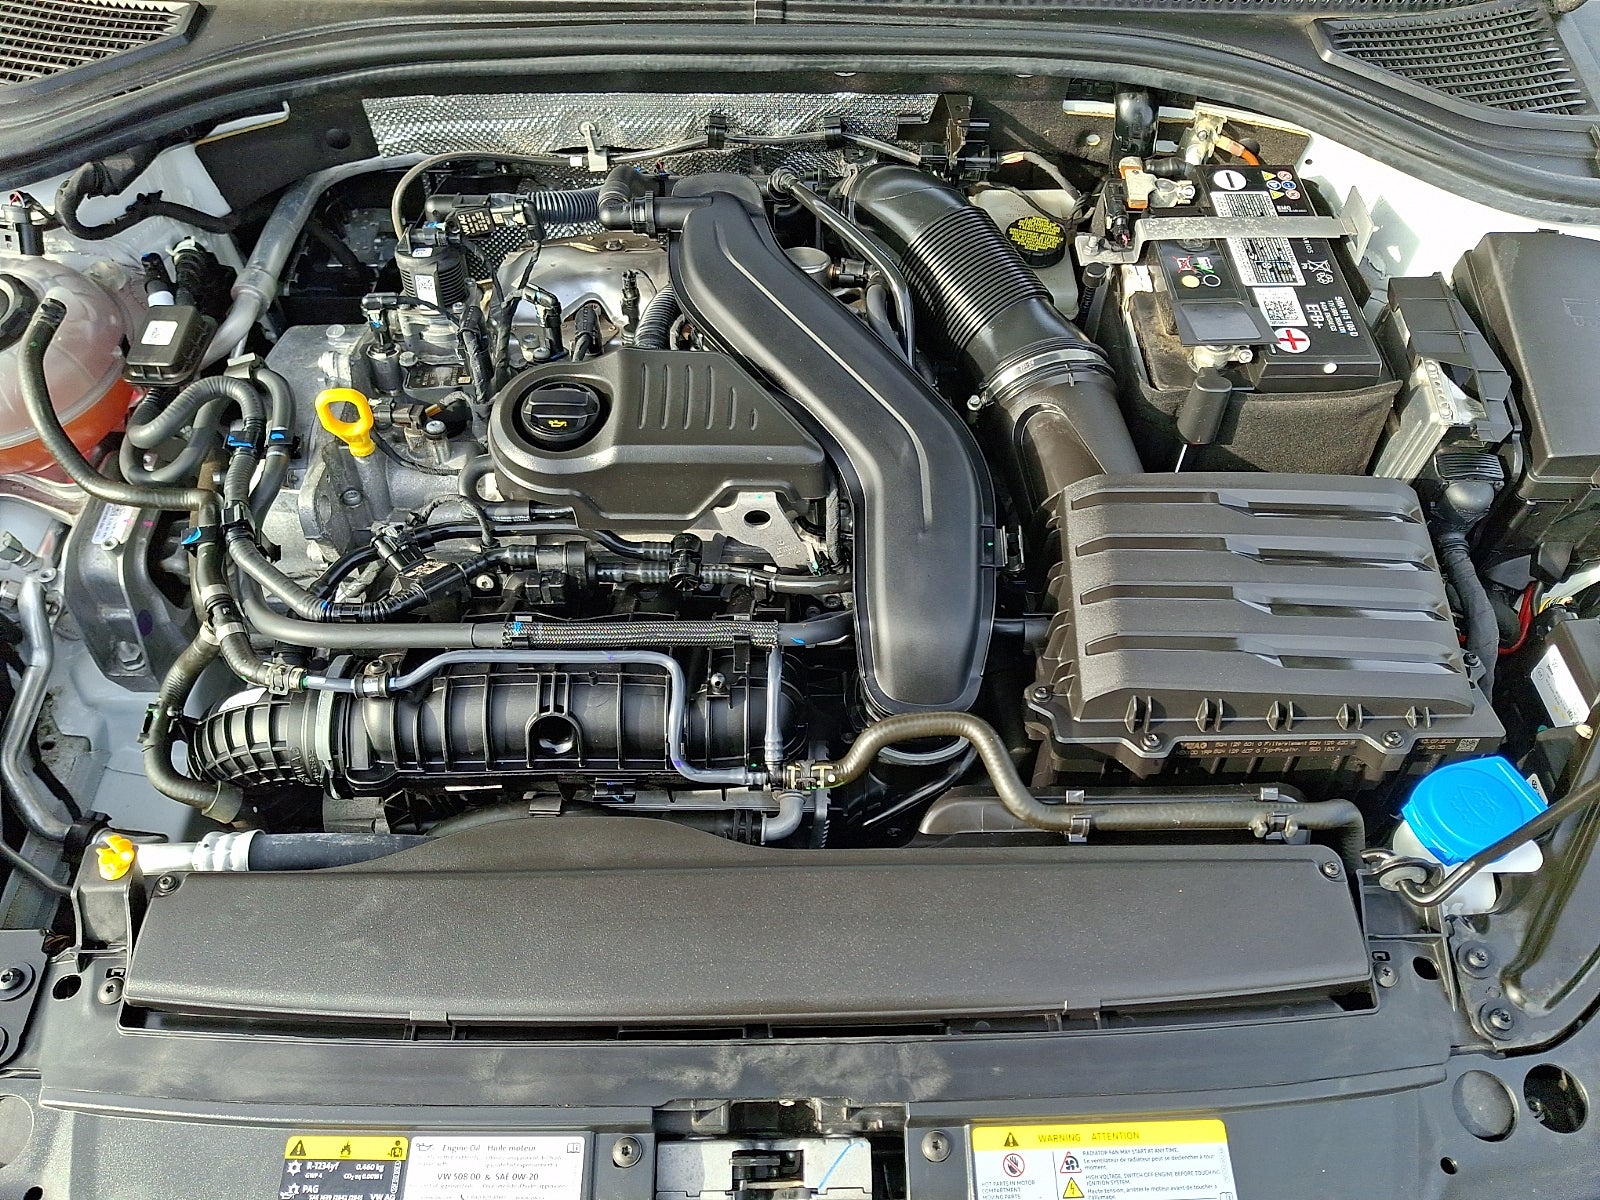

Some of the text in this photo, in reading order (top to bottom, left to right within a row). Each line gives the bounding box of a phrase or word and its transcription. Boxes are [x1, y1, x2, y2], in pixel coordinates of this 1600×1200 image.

[1305, 304, 1324, 329] EFB+
[1340, 309, 1352, 320] 915
[1345, 321, 1357, 332] 105
[1038, 1131, 1140, 1143] WARNING ATTENTION
[442, 1144, 481, 1154] Engine Oil
[487, 1144, 536, 1152] Huile moteur
[306, 1161, 341, 1173] R-1234yf
[355, 1163, 385, 1173] 0.460 kg
[437, 1172, 452, 1181] VW
[453, 1172, 469, 1181] 508
[469, 1172, 482, 1181] 00
[484, 1173, 491, 1181] &
[495, 1172, 510, 1181] SAE
[302, 1185, 320, 1194] PAG
